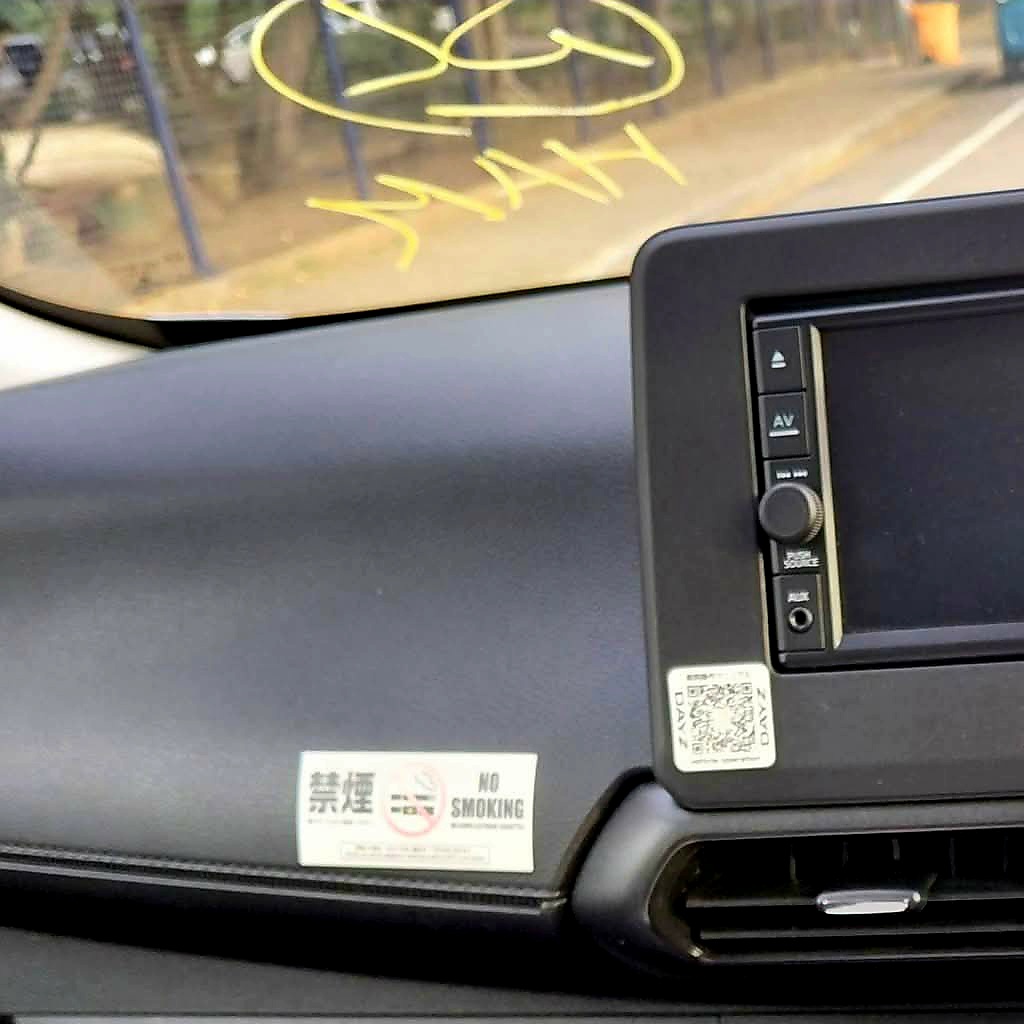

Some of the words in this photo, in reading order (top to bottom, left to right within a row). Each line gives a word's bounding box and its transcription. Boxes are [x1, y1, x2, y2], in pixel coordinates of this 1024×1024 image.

[773, 414, 795, 429] AV
[309, 771, 376, 814] 禁煙
[478, 771, 500, 793] NO
[451, 797, 525, 820] SMOKING
